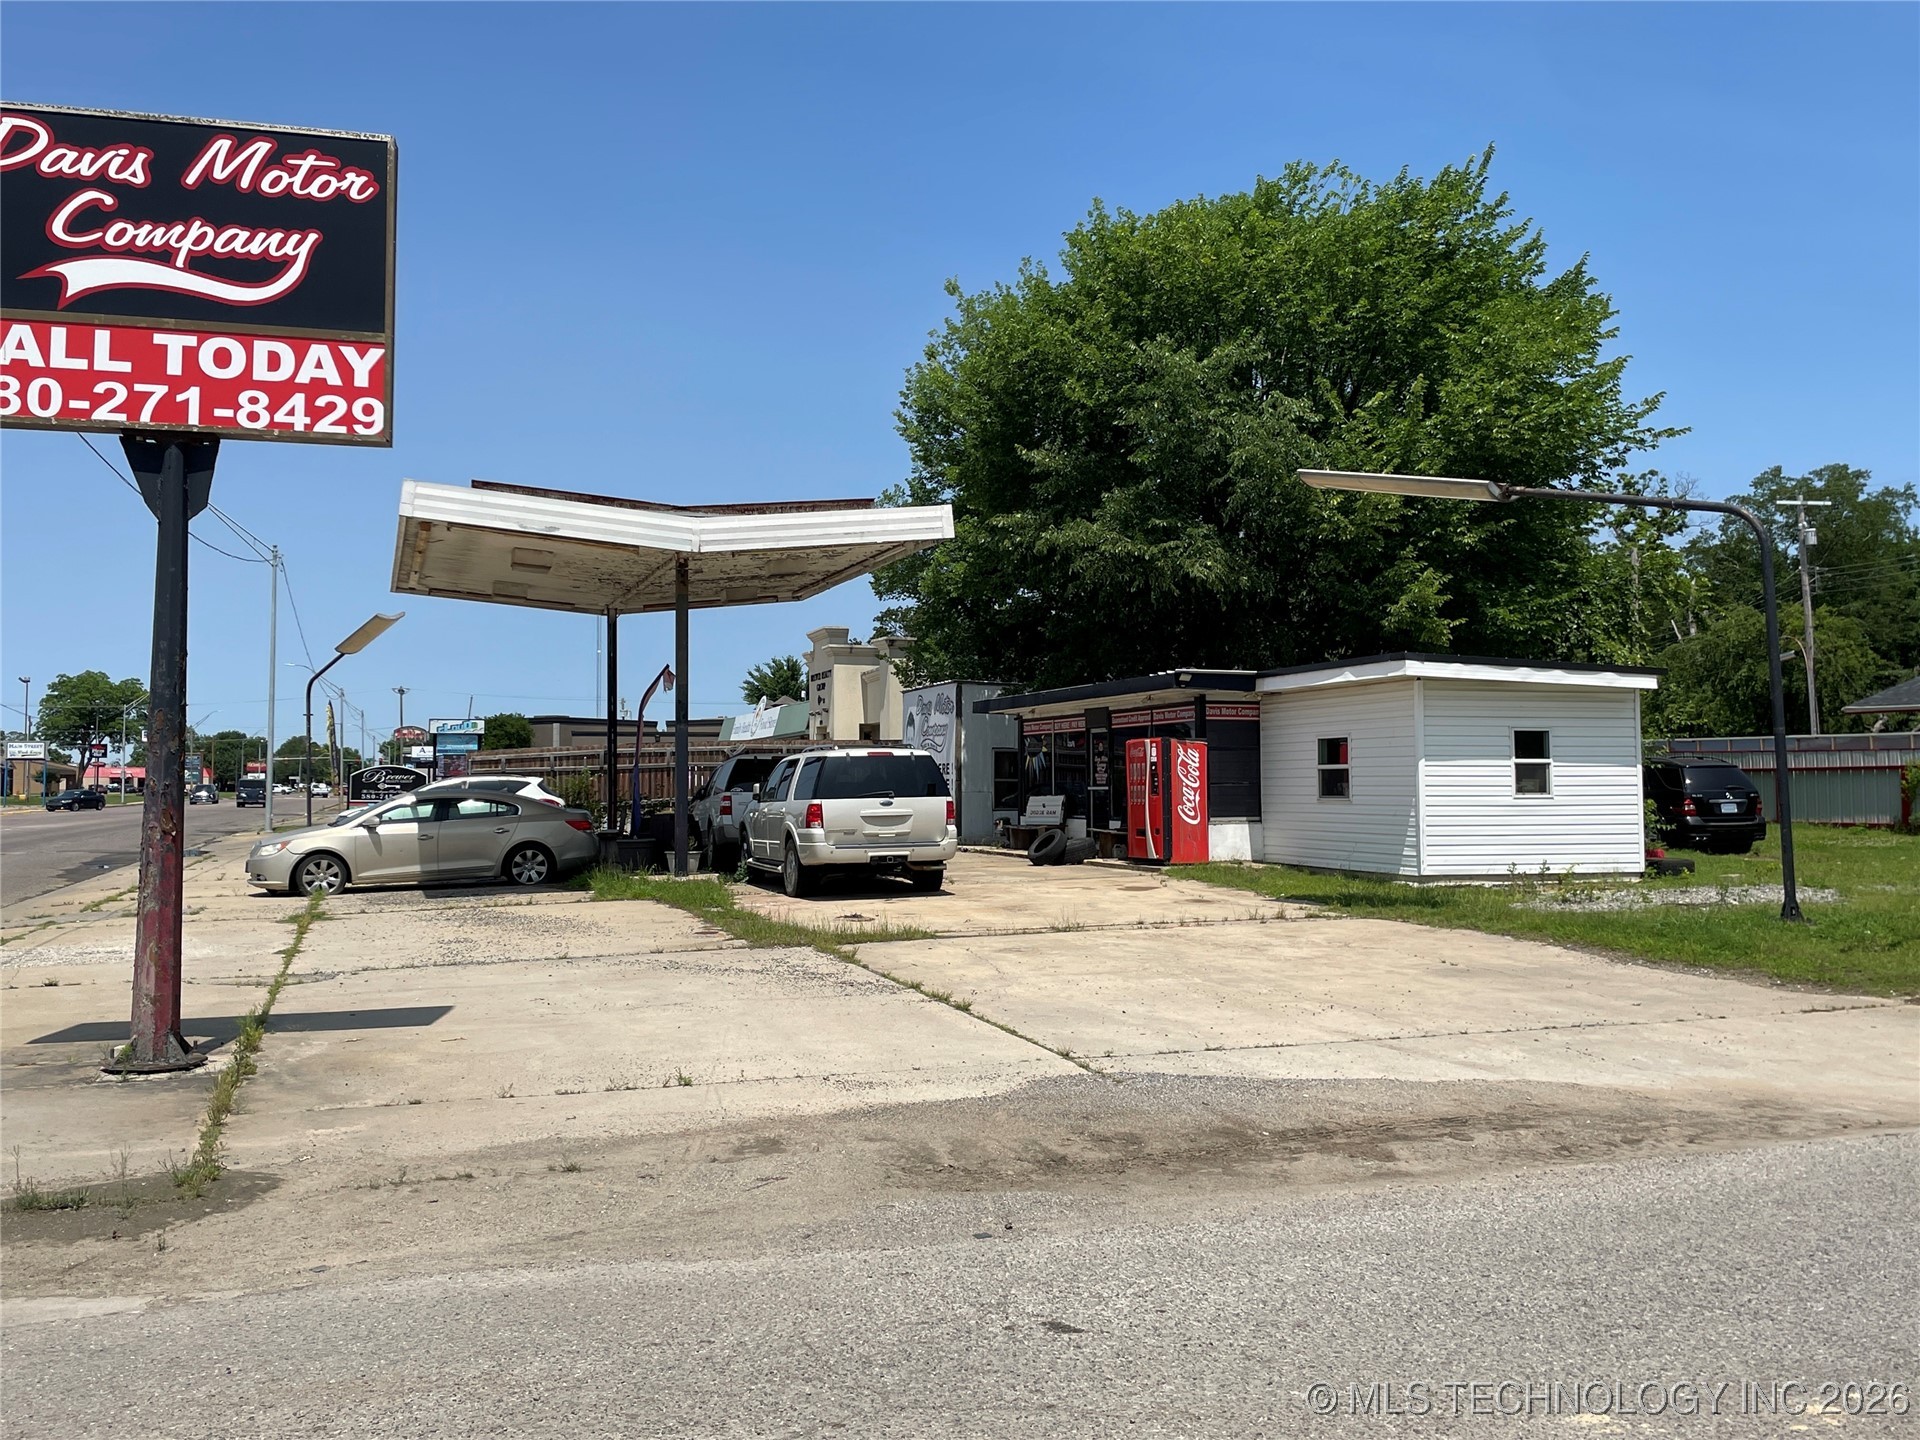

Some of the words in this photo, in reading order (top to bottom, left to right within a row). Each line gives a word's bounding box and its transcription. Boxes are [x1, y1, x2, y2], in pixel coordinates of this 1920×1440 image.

[0, 115, 151, 186] Davis
[183, 137, 377, 201] Motor
[50, 188, 321, 278] Company
[153, 333, 385, 388] TODAY
[1205, 707, 1220, 715] Davis
[1221, 707, 1237, 715] Motor
[361, 769, 417, 783] Brewer
[1178, 743, 1201, 825] Coca-Cola
